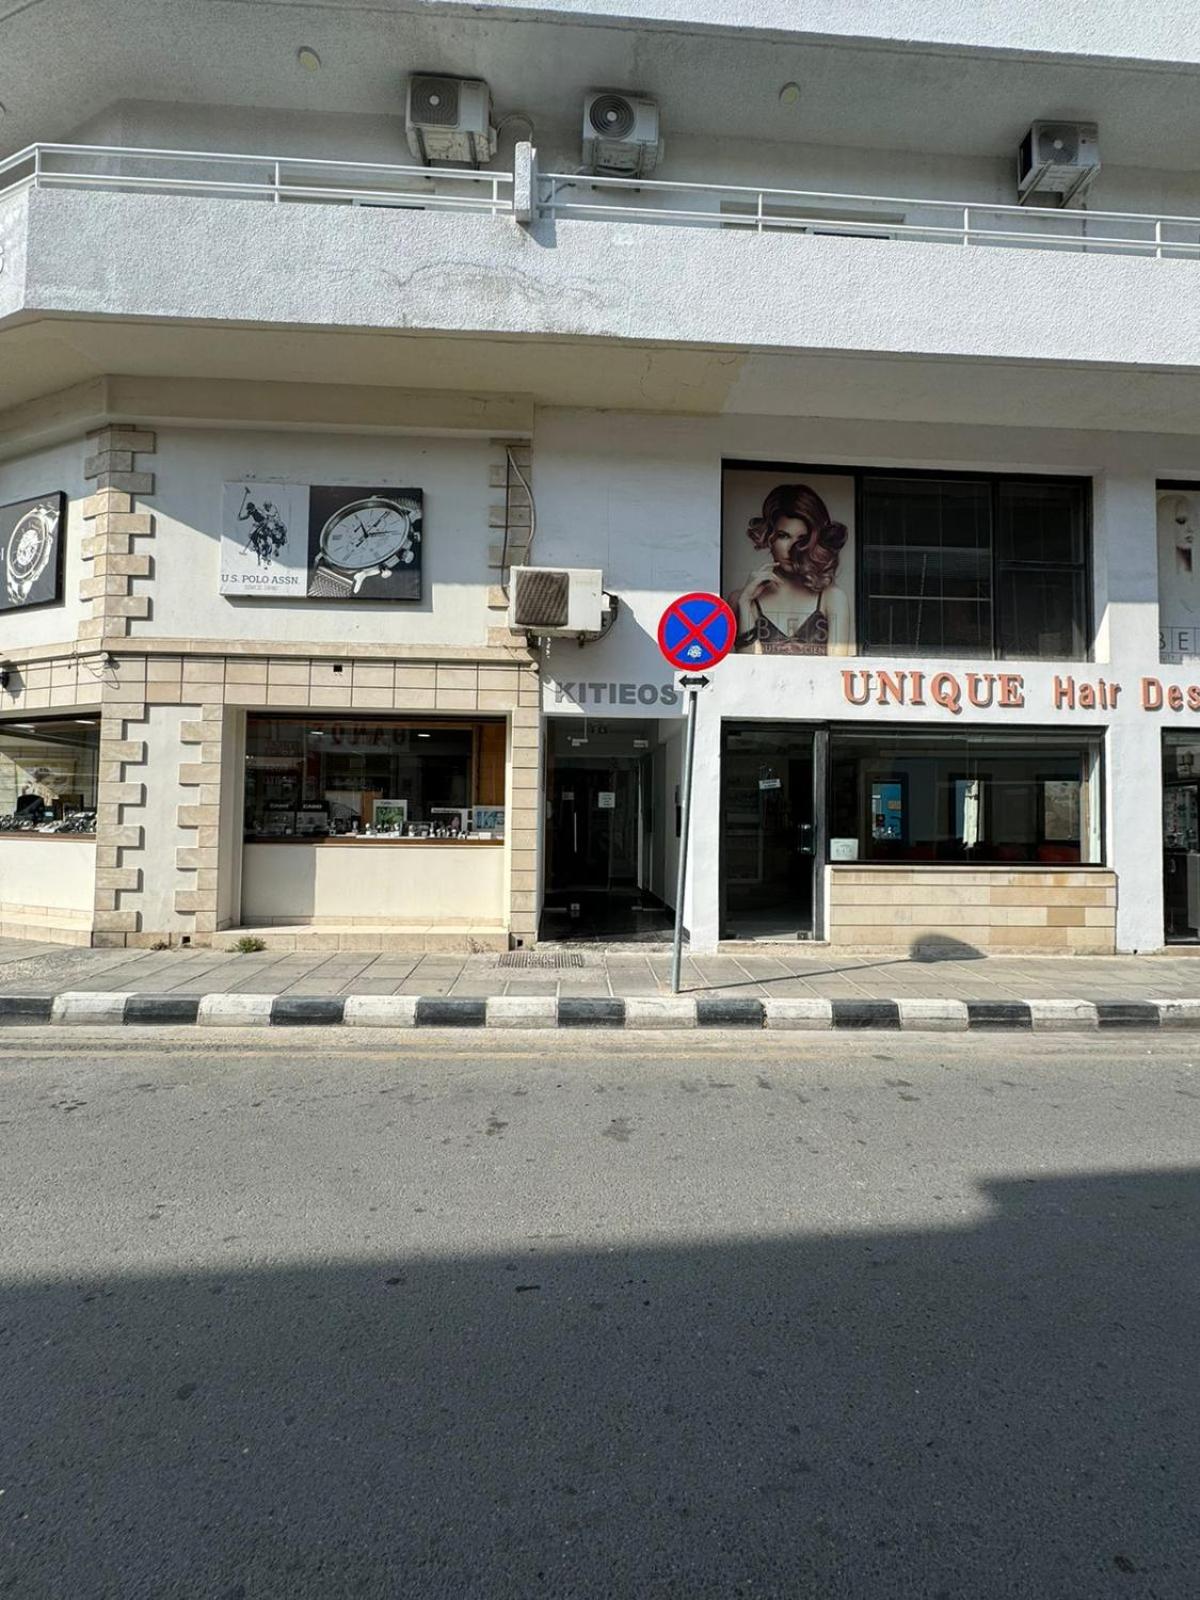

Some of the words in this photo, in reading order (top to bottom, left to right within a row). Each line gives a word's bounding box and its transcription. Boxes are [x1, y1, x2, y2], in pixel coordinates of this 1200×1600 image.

[242, 575, 269, 584] POLO
[555, 682, 678, 706] KITIEOS
[840, 670, 1025, 715] UNIQUE
[1053, 675, 1122, 711] Hair
[1141, 676, 1200, 712] Des
